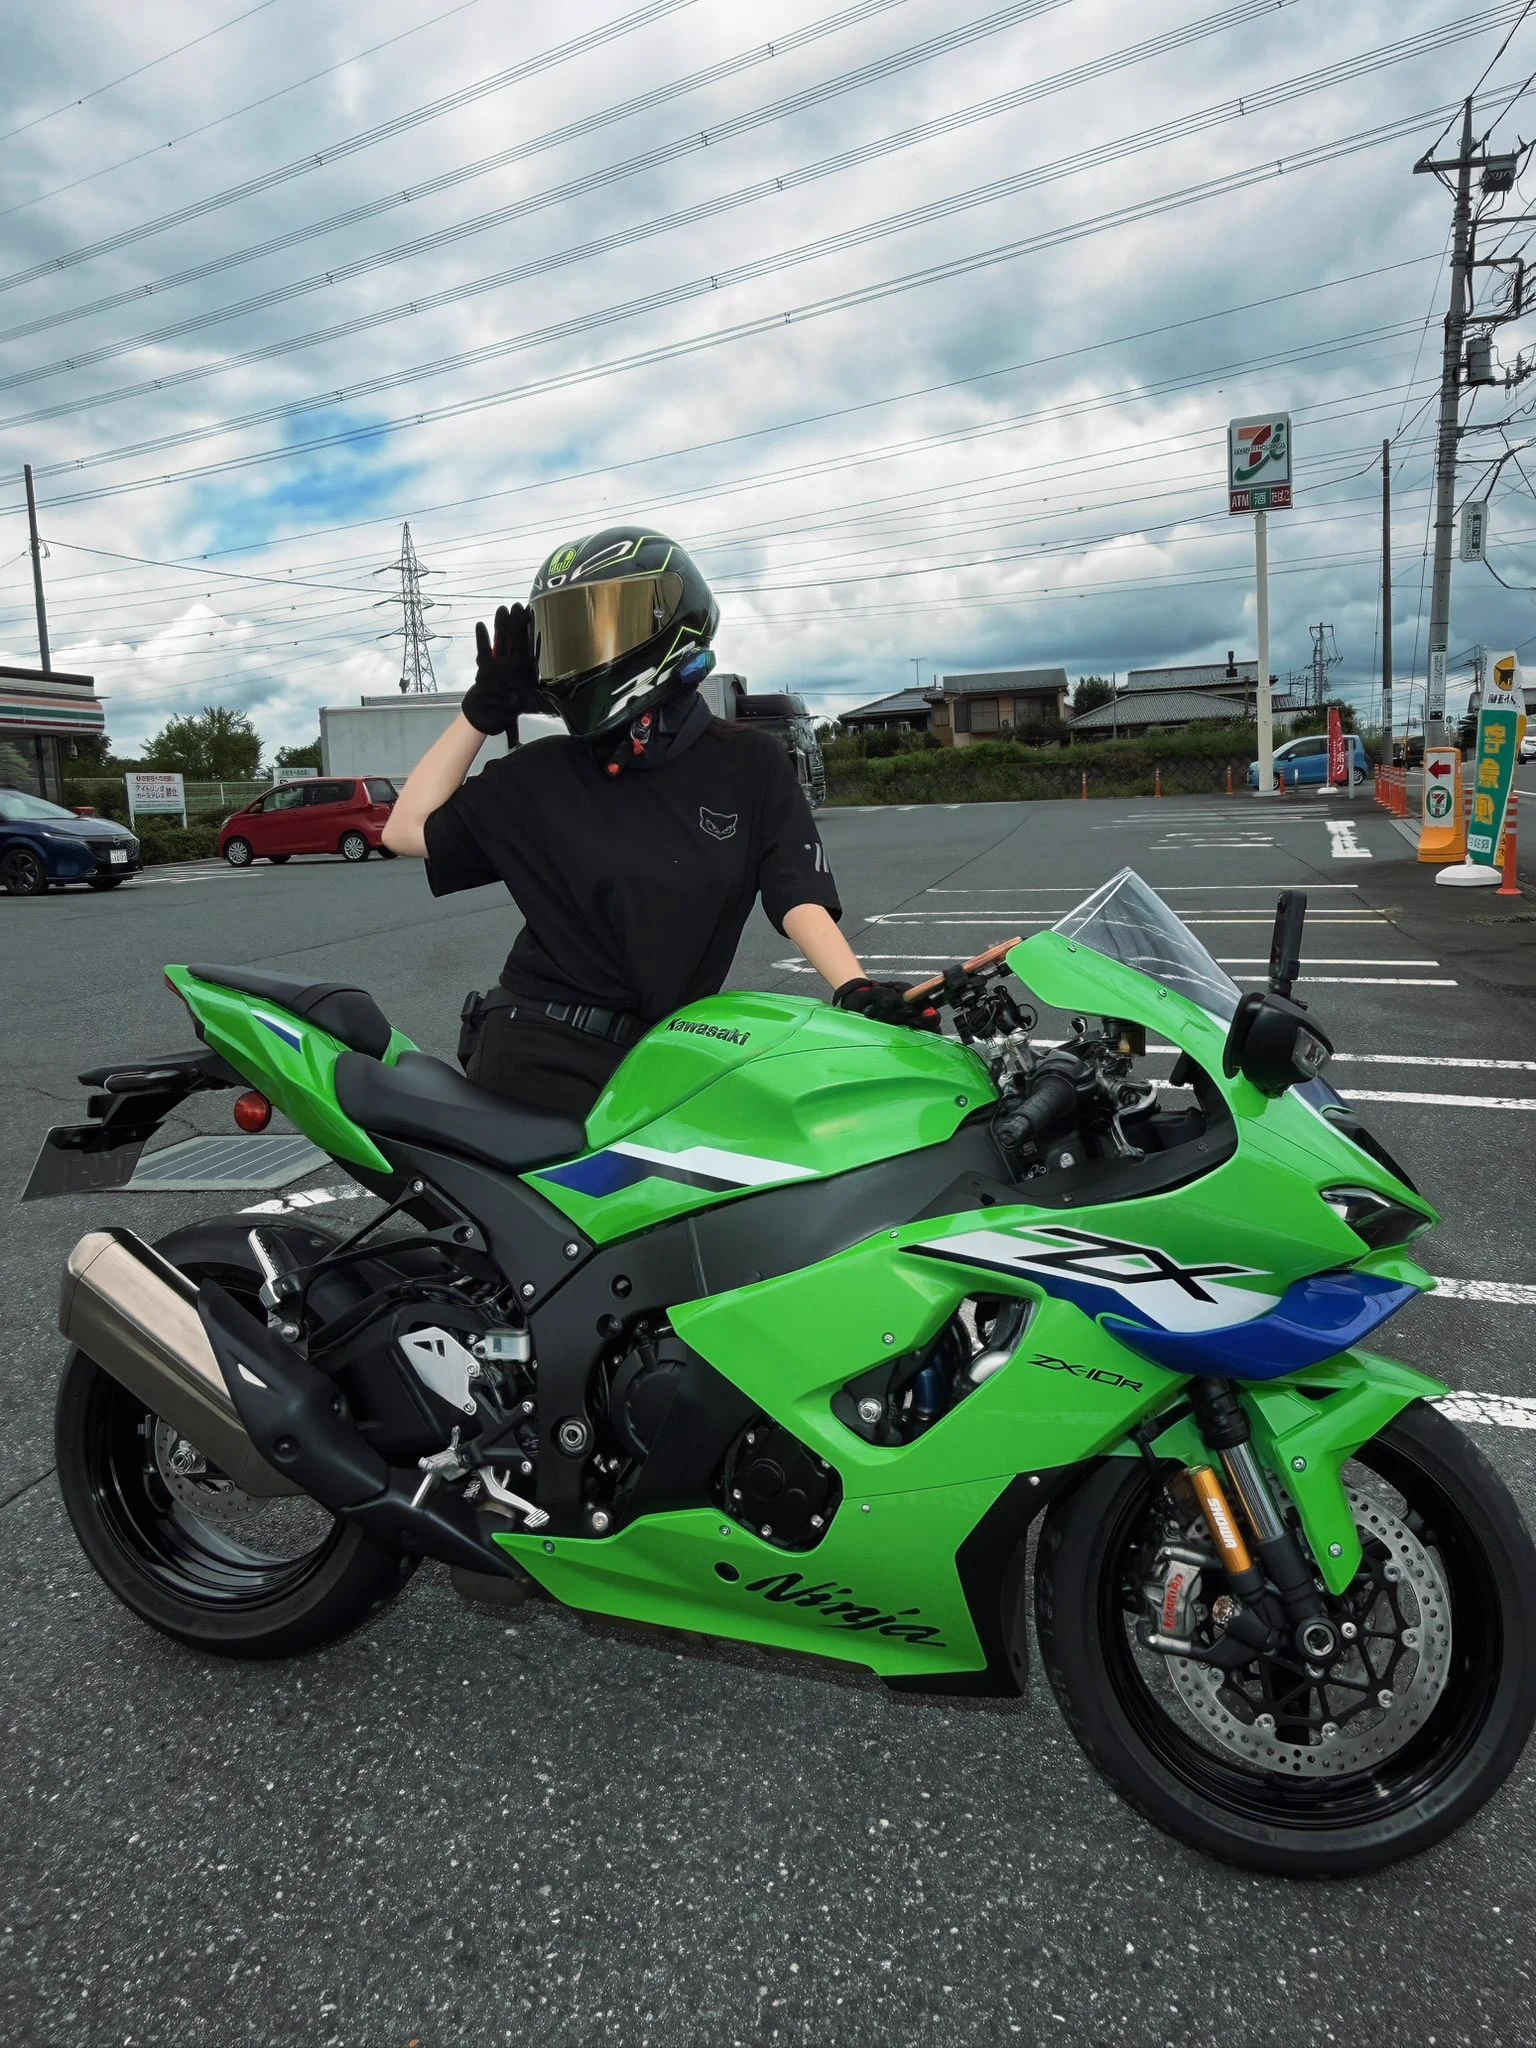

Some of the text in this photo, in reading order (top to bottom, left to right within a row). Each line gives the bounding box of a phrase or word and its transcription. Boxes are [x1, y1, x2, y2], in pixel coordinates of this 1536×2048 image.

[1232, 489, 1290, 508] ATM 酒 たばこ
[665, 1018, 751, 1046] Kawasaki
[1027, 1353, 1144, 1393] ZX-10R
[1207, 1497, 1238, 1549] SHOWA
[744, 1572, 948, 1648] Ninja
